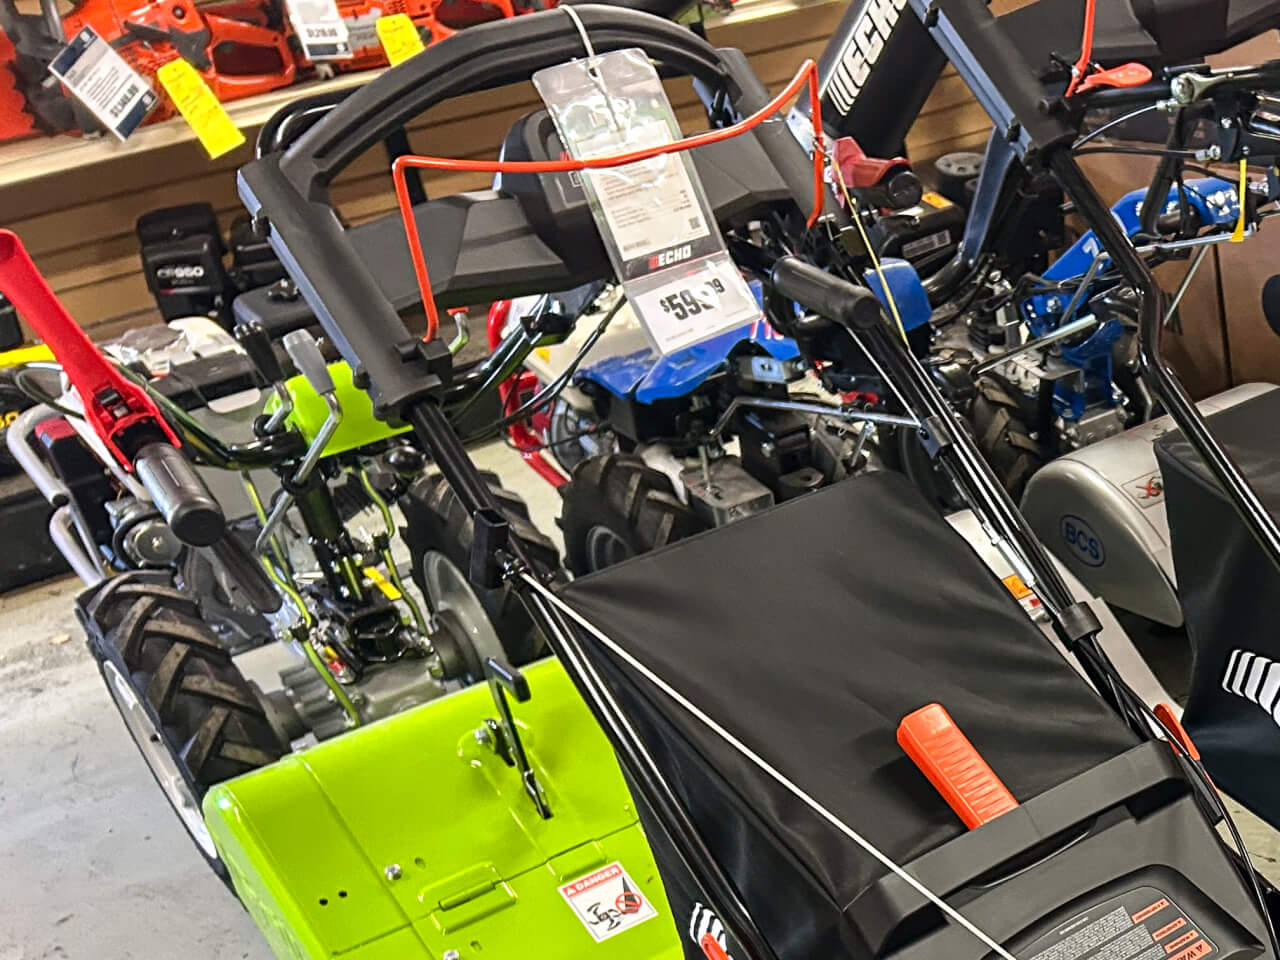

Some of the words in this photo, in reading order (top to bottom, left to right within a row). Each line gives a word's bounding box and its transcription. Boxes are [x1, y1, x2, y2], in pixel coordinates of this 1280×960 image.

[653, 245, 692, 267] ECHO
[1063, 523, 1102, 560] BCS
[576, 866, 619, 890] DANGER
